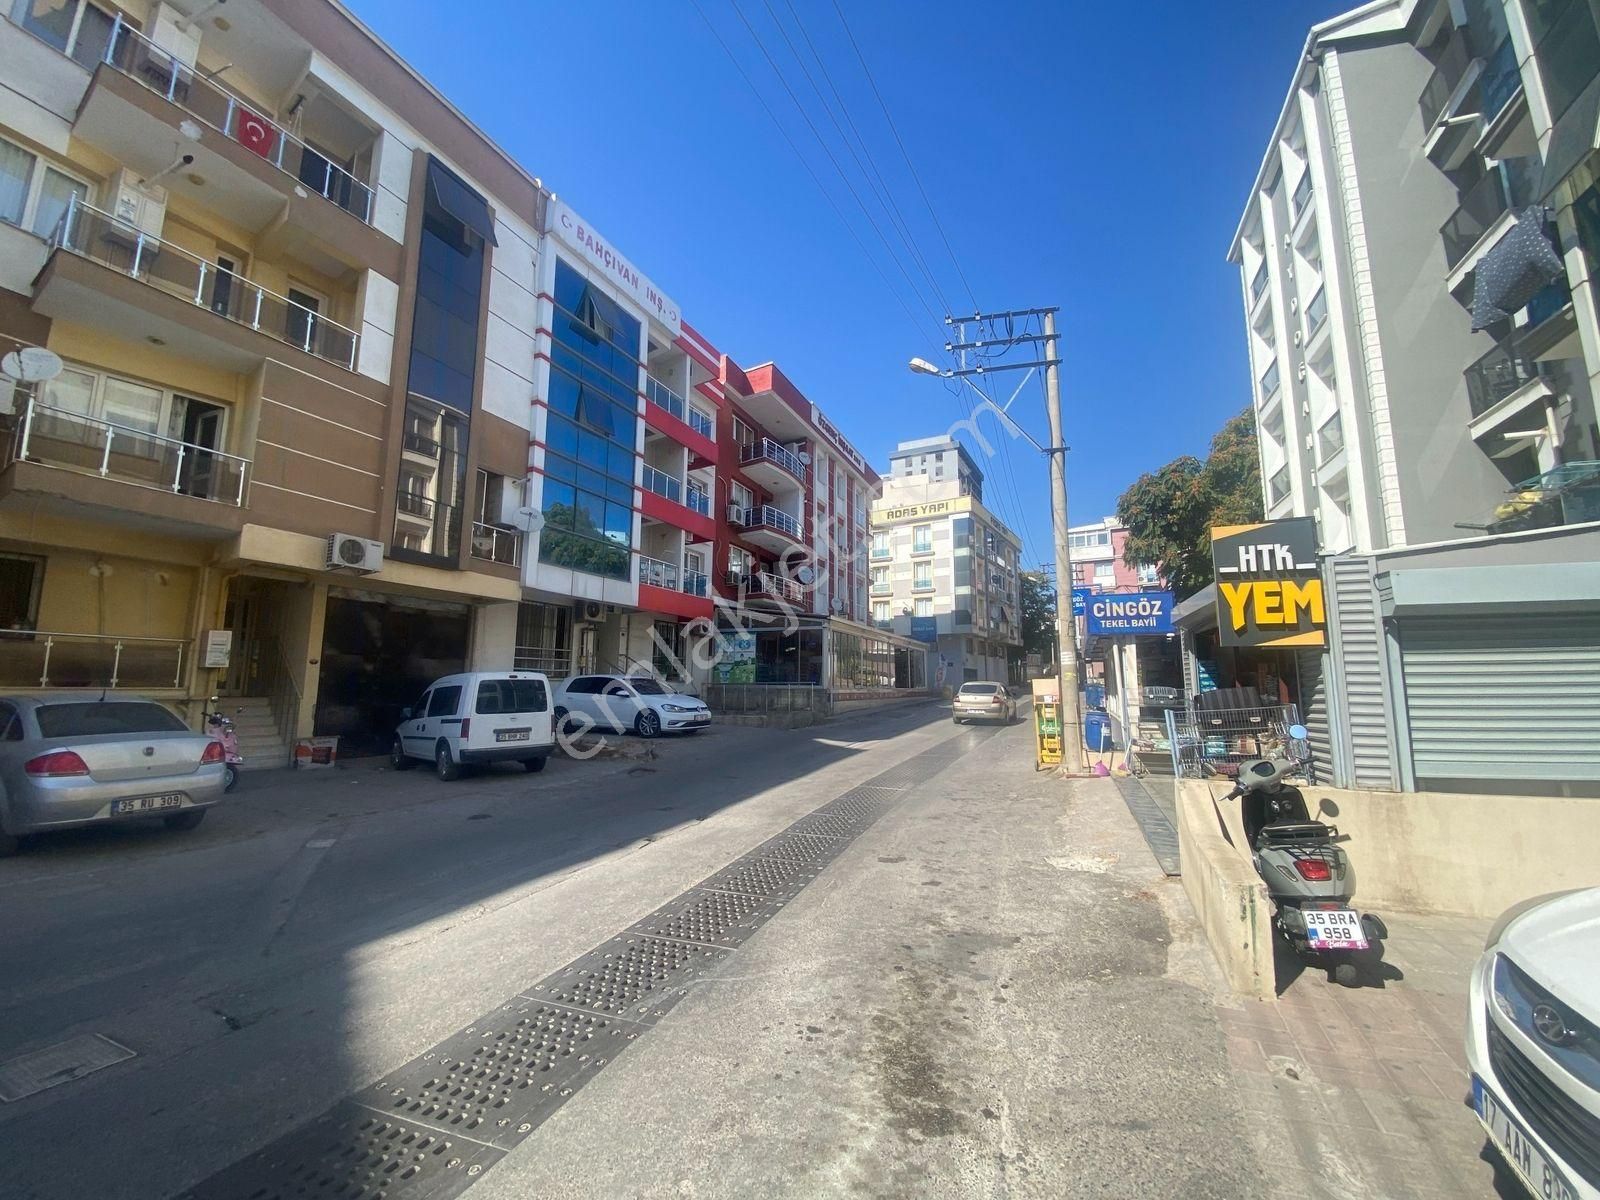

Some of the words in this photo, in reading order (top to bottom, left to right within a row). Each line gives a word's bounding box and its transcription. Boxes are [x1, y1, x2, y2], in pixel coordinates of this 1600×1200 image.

[576, 225, 639, 288] BAHÇIVAN
[887, 507, 917, 519] ADAS
[920, 502, 948, 513] YAPI
[1238, 544, 1293, 572] HTK
[1093, 598, 1162, 618] CİNGÖZ
[1219, 579, 1325, 631] YEM
[1100, 620, 1130, 628] TEKEL
[1131, 617, 1156, 627] BAYİİ
[120, 800, 134, 811] 35
[140, 798, 154, 809] RU
[160, 795, 179, 806] 309
[1307, 913, 1325, 924] 35
[1328, 913, 1356, 925] BRA
[1324, 927, 1351, 938] 958
[1484, 1094, 1496, 1129] 17
